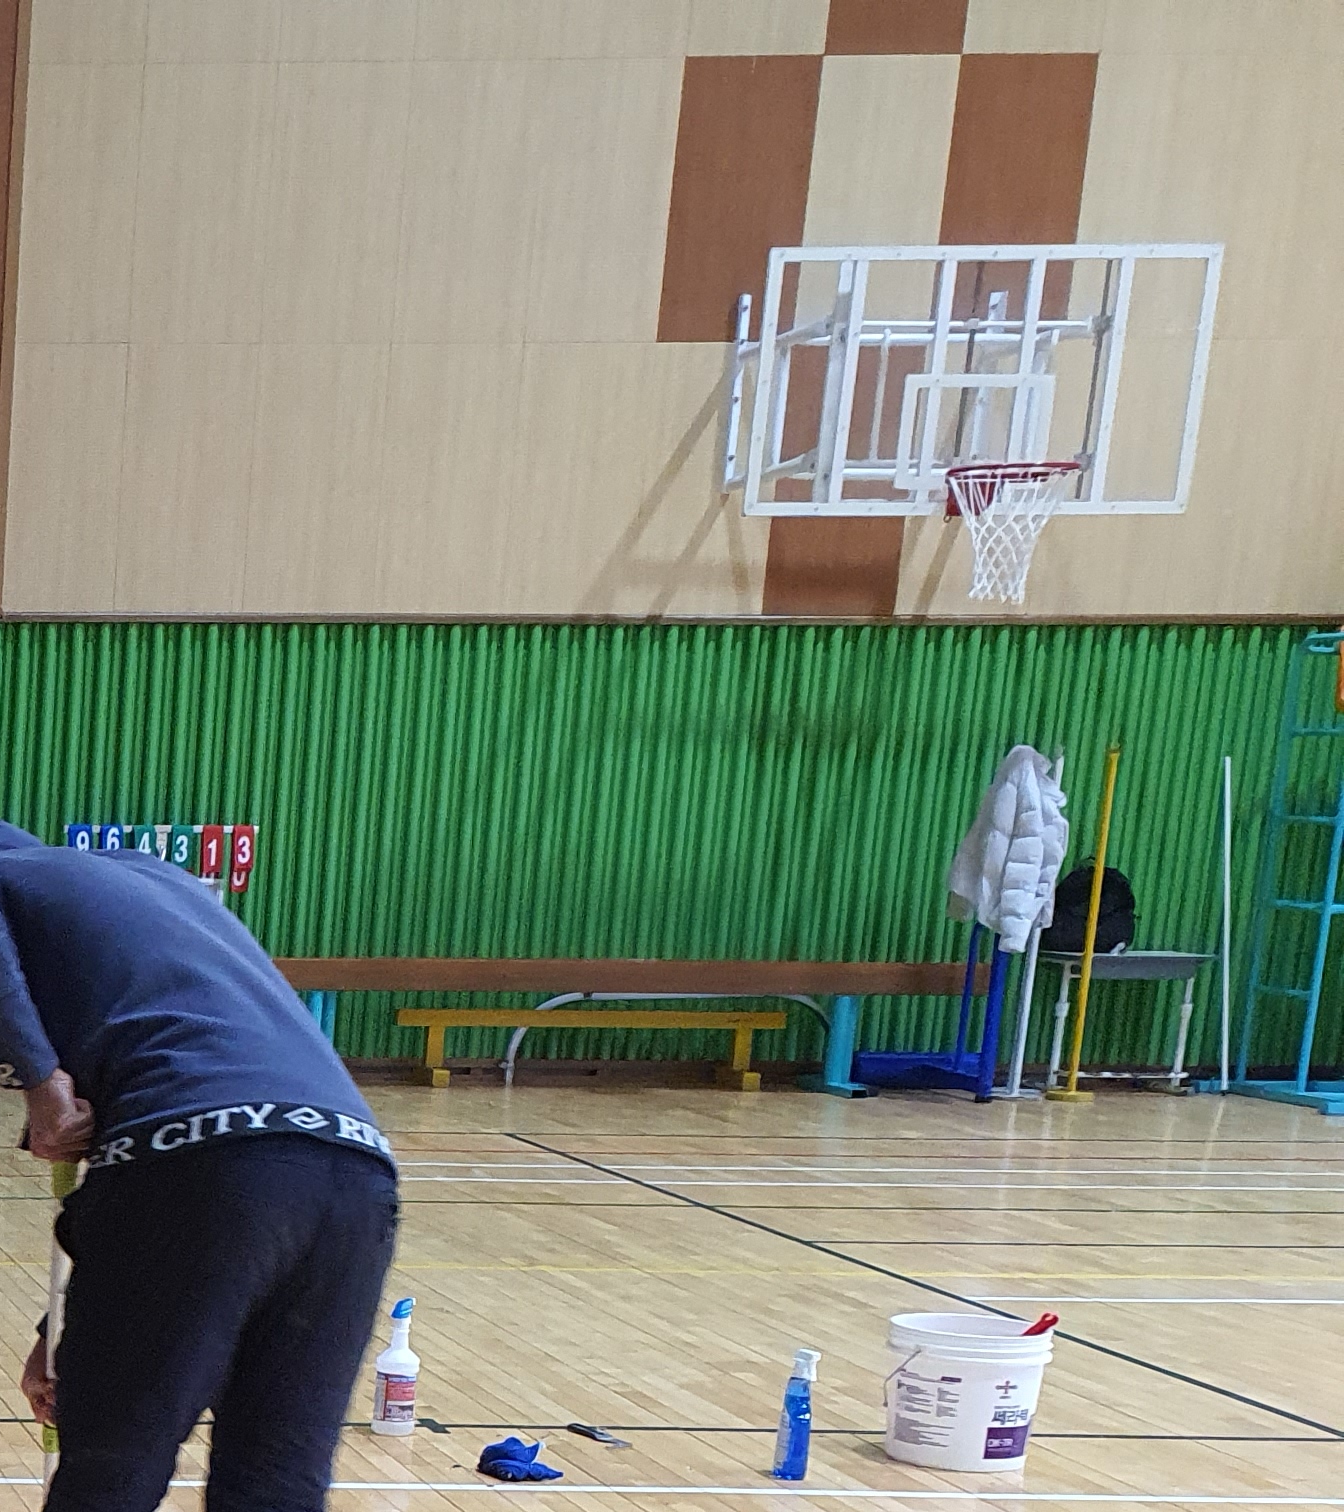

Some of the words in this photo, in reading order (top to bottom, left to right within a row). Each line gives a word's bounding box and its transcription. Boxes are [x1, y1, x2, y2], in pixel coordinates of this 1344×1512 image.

[174, 835, 189, 863] 3
[237, 835, 251, 864] 3
[151, 1103, 277, 1151] CITY
